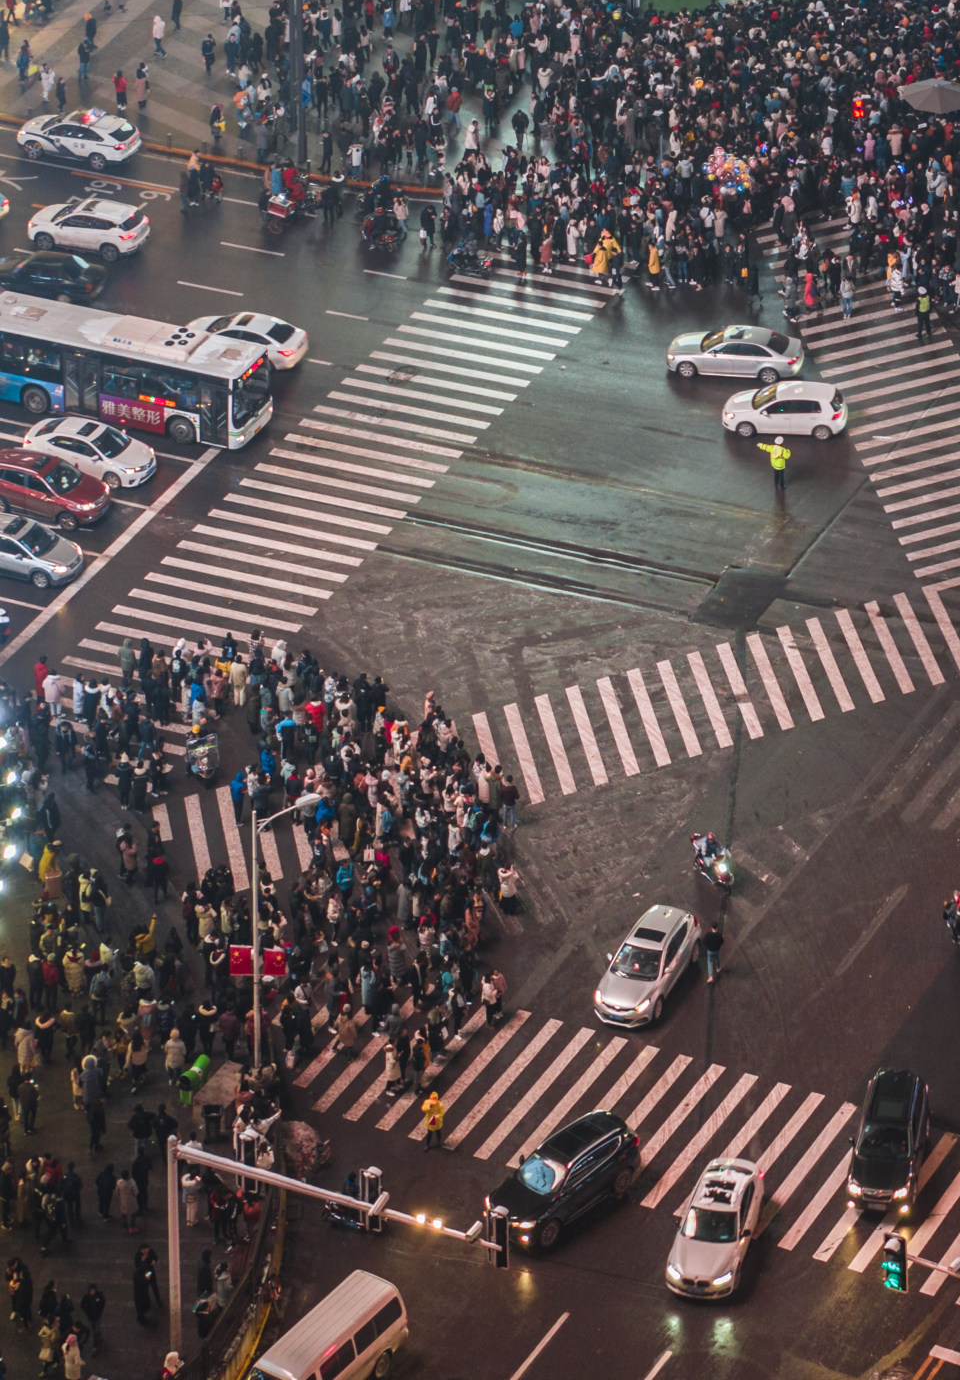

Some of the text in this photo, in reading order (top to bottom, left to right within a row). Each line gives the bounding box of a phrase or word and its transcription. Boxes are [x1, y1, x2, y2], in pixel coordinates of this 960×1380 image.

[73, 141, 86, 149] 公安
[101, 399, 162, 426] 雅美整形
